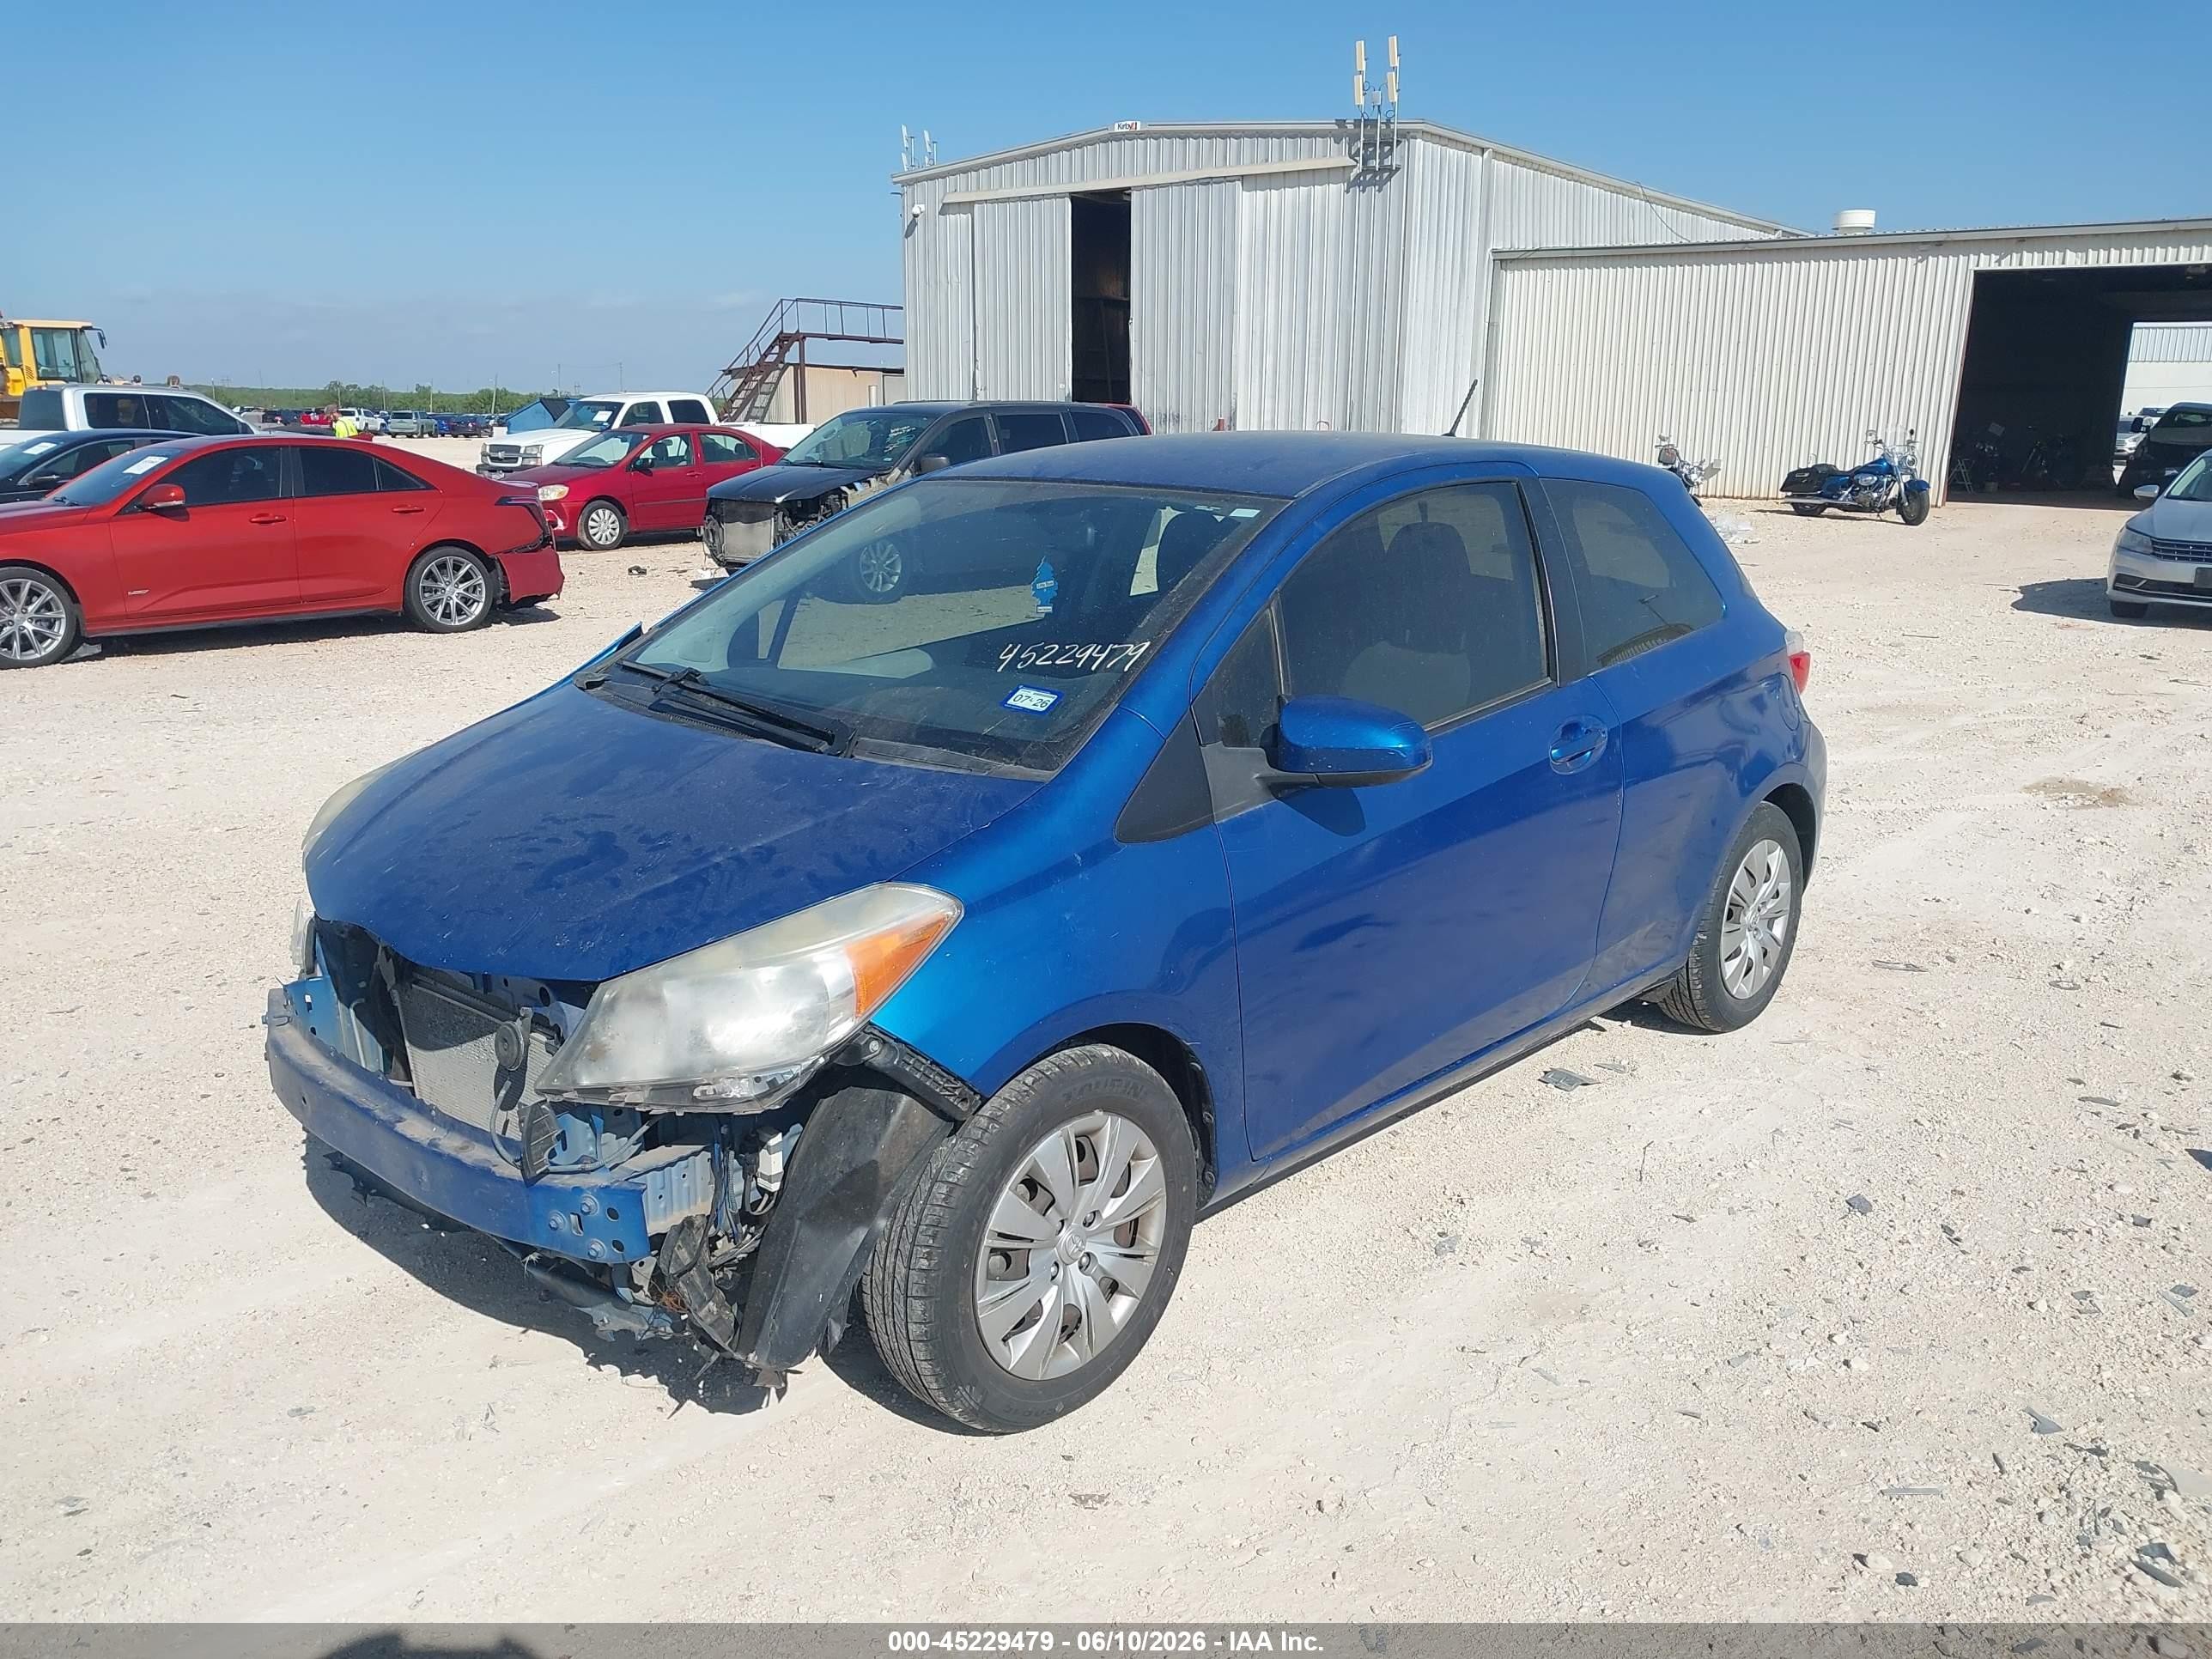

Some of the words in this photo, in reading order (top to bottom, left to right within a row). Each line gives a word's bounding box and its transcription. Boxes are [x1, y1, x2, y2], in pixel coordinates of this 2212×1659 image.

[996, 641, 1151, 672] 45229479
[1013, 694, 1030, 703] 07
[1031, 698, 1051, 708] 26
